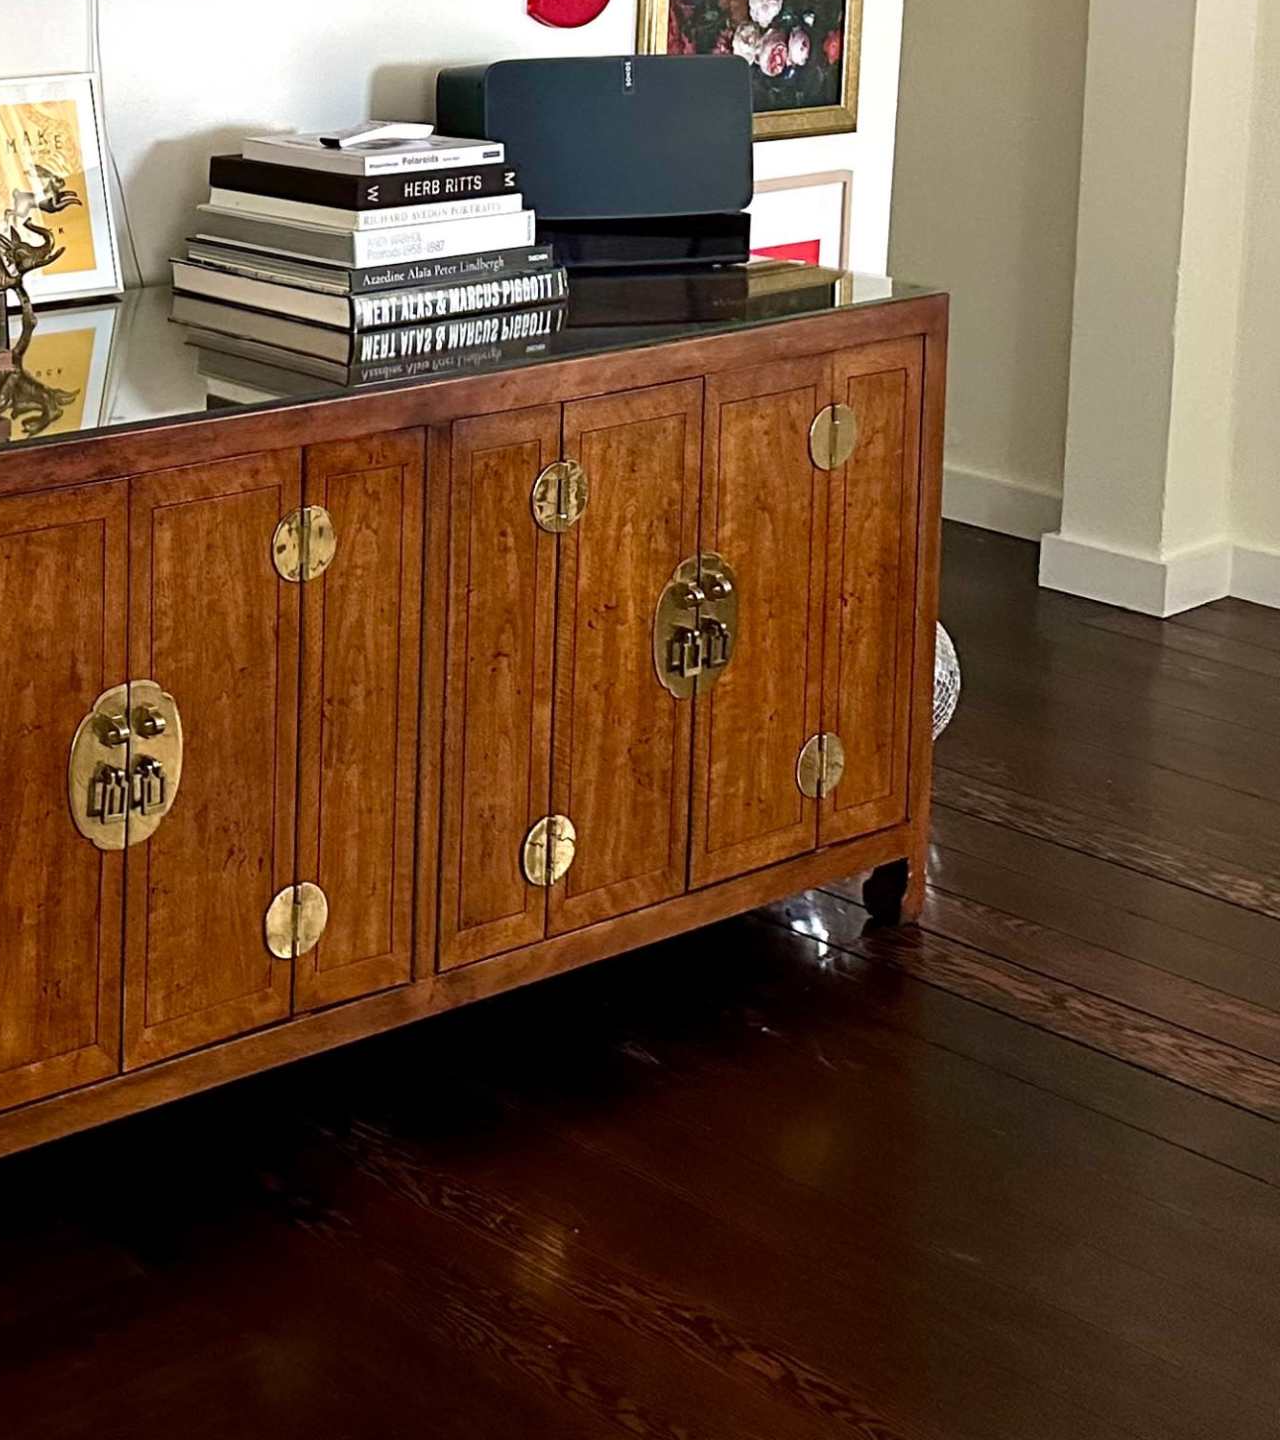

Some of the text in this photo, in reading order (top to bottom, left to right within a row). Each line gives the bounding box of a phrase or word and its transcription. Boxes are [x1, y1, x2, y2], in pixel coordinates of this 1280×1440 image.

[624, 61, 632, 87] SONOS
[6, 129, 63, 154] MAKE
[404, 179, 440, 197] HERB
[445, 175, 482, 193] RITTS
[363, 211, 408, 226] RICHARD
[412, 207, 448, 220] AVEDON
[434, 263, 457, 276] Peter
[459, 255, 504, 273] Lindbergh
[363, 273, 552, 327] MERT ALAS & MARCUS PIGGOTT
